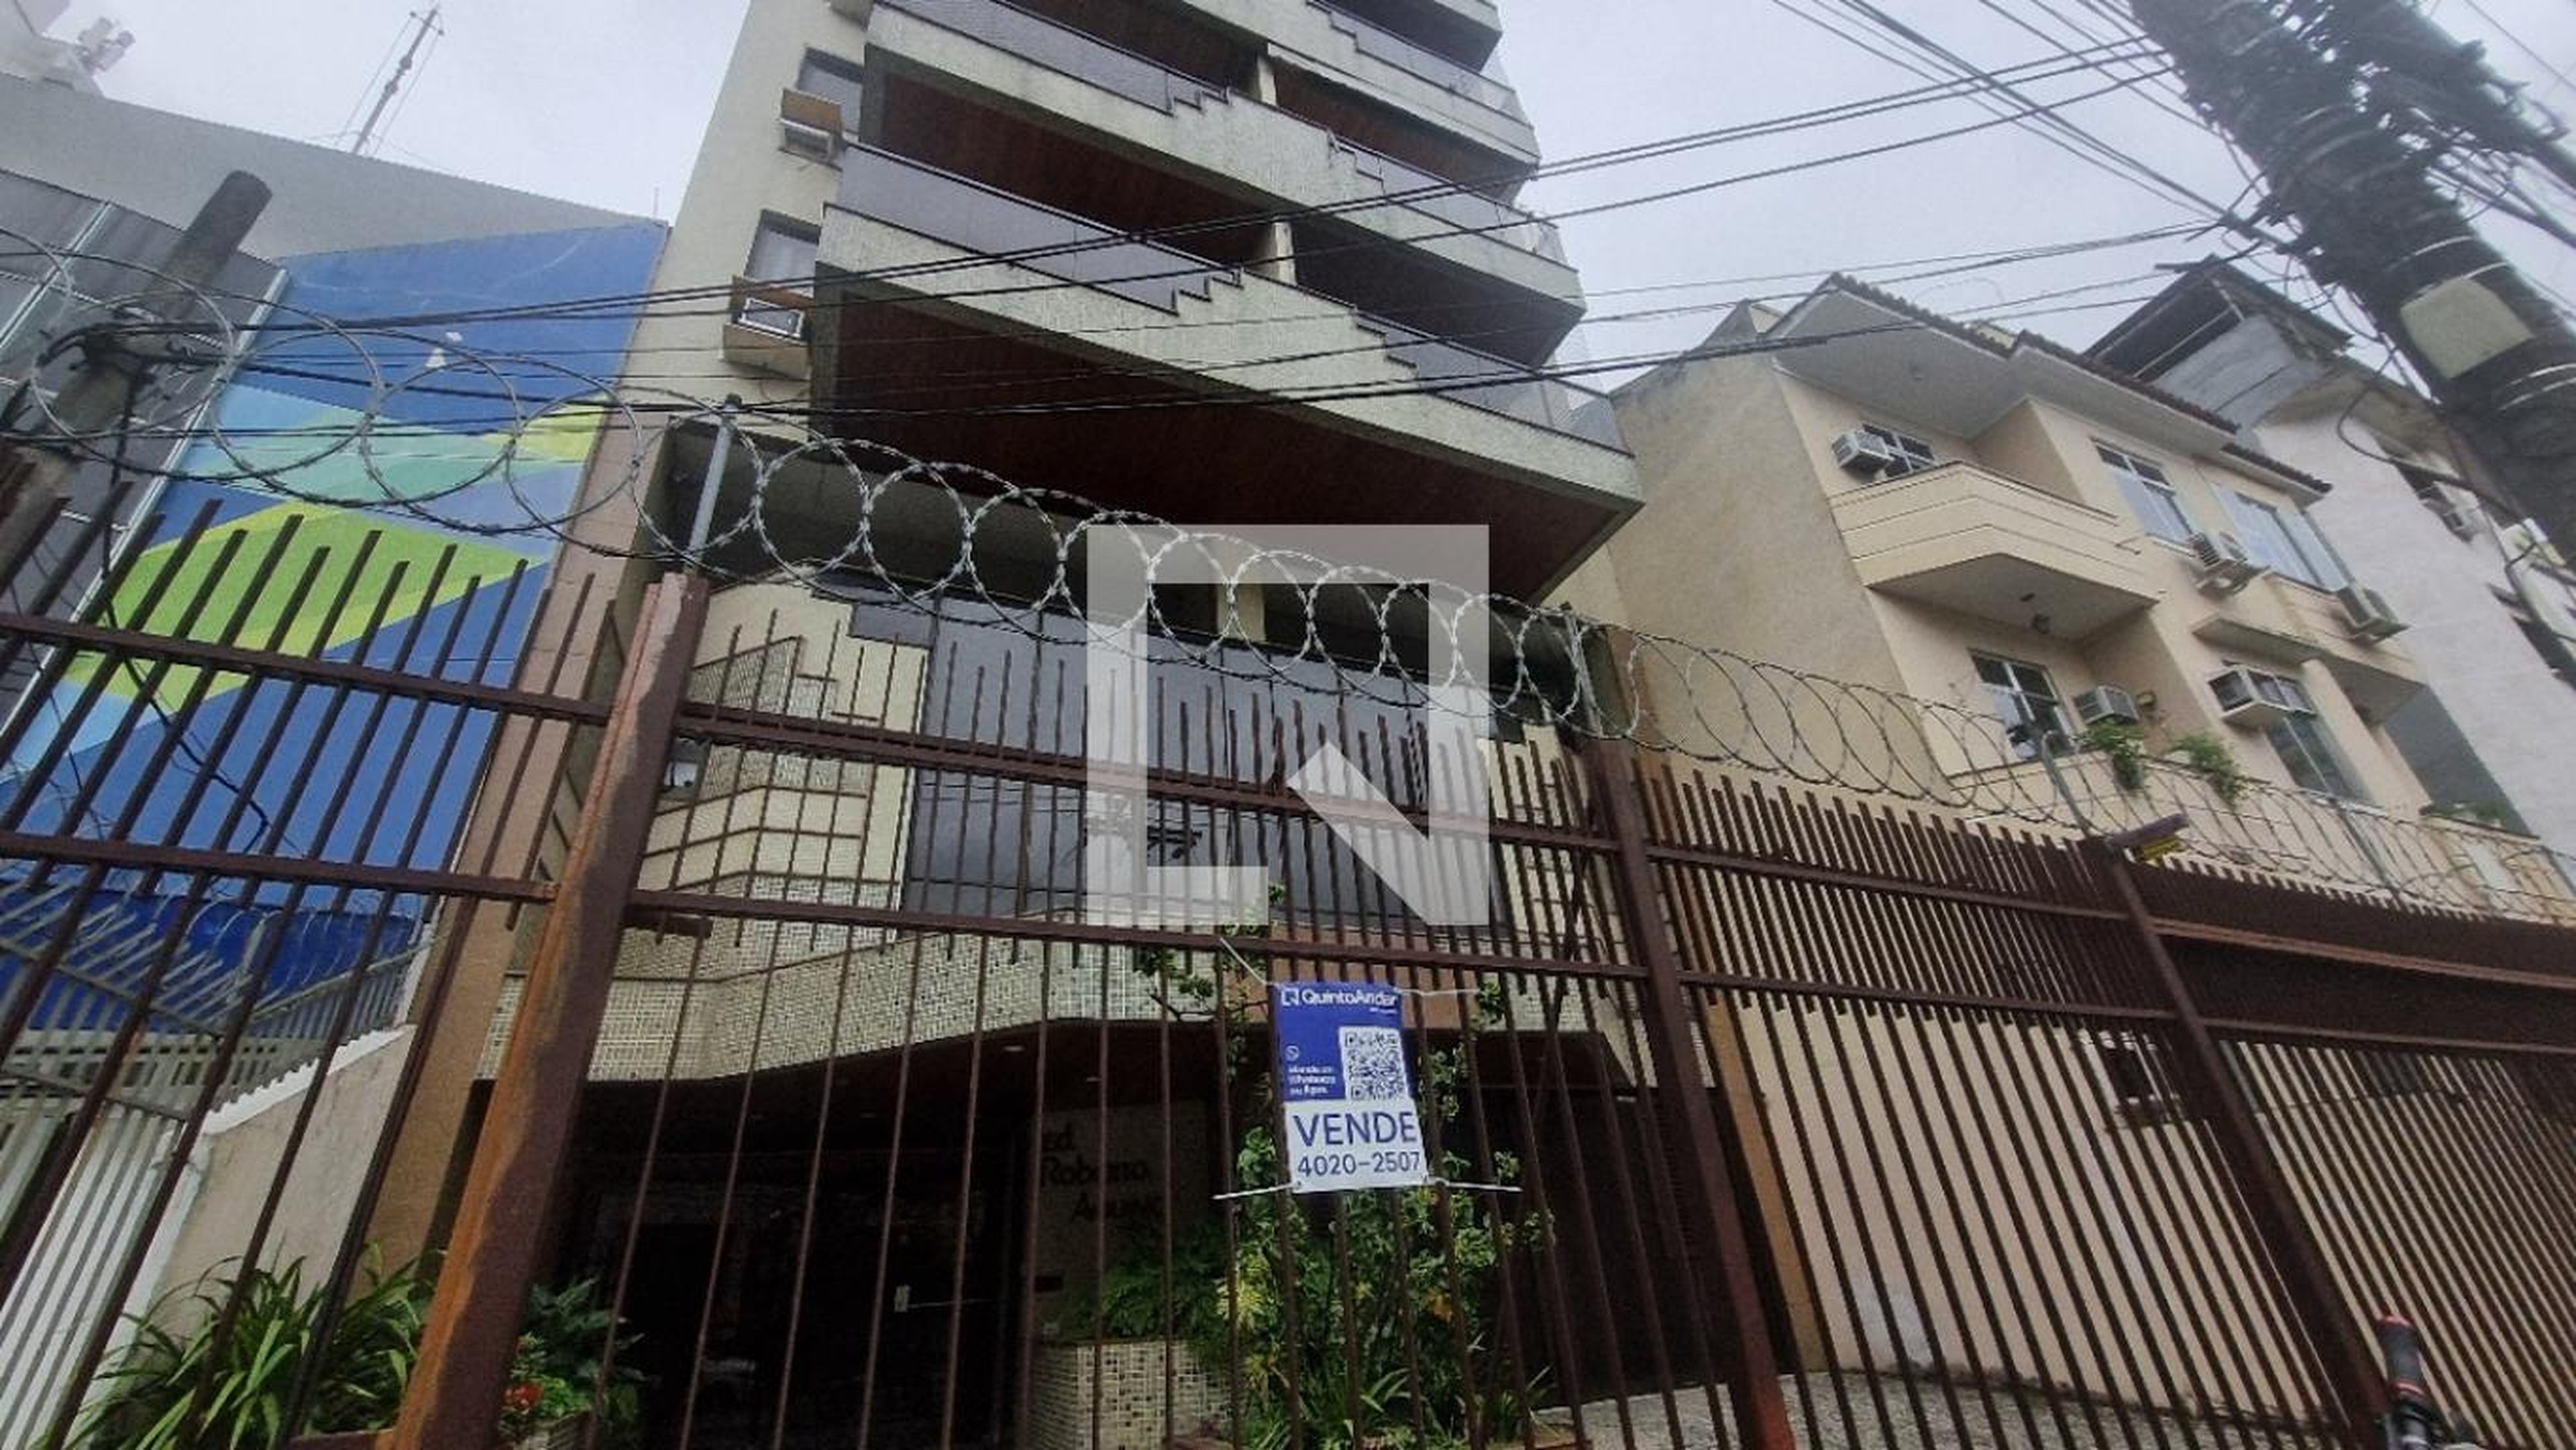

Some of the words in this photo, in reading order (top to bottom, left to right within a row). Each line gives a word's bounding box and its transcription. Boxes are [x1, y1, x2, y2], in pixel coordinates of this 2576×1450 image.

[1301, 988, 1397, 1006] QuintoAndar
[1293, 1111, 1417, 1147] VENDE
[1298, 1151, 1420, 1176] 4020-2507
